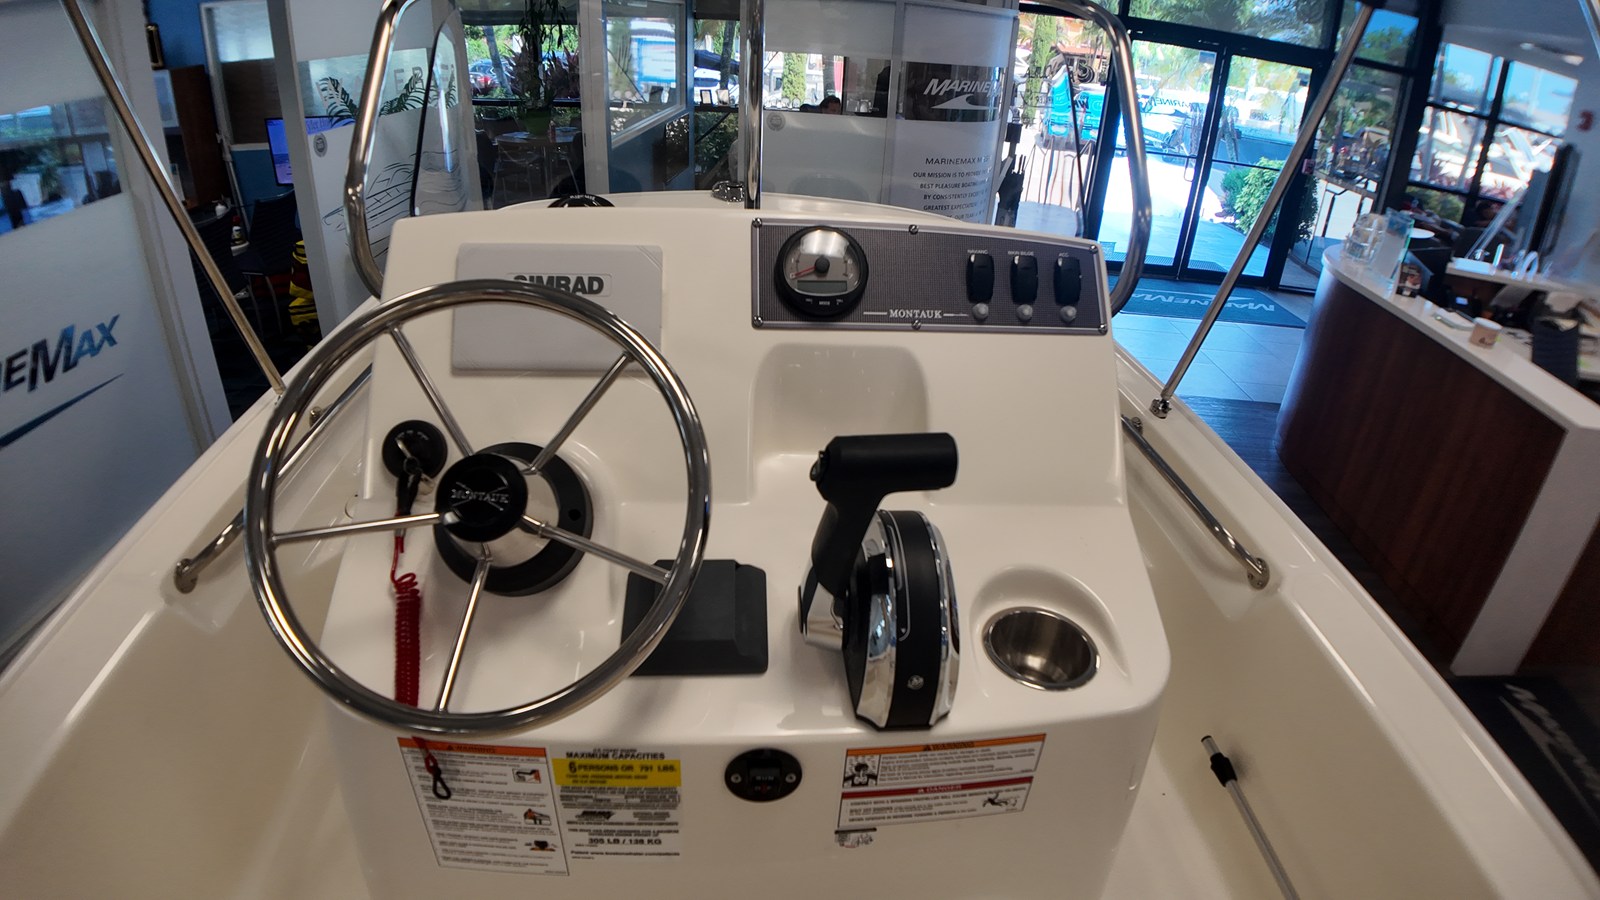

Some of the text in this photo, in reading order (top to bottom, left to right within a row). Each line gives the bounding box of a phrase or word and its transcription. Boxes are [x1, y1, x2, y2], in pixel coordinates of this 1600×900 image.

[925, 157, 976, 165] MARINEMAX
[513, 275, 605, 295] MRAD
[889, 309, 943, 320] MONTAUK
[0, 313, 120, 393] EMAX
[451, 488, 510, 504] MONTAUK
[611, 752, 666, 760] CAPACITIES
[568, 760, 577, 774] 6
[577, 763, 619, 772] PERSONS
[621, 764, 634, 772] OR
